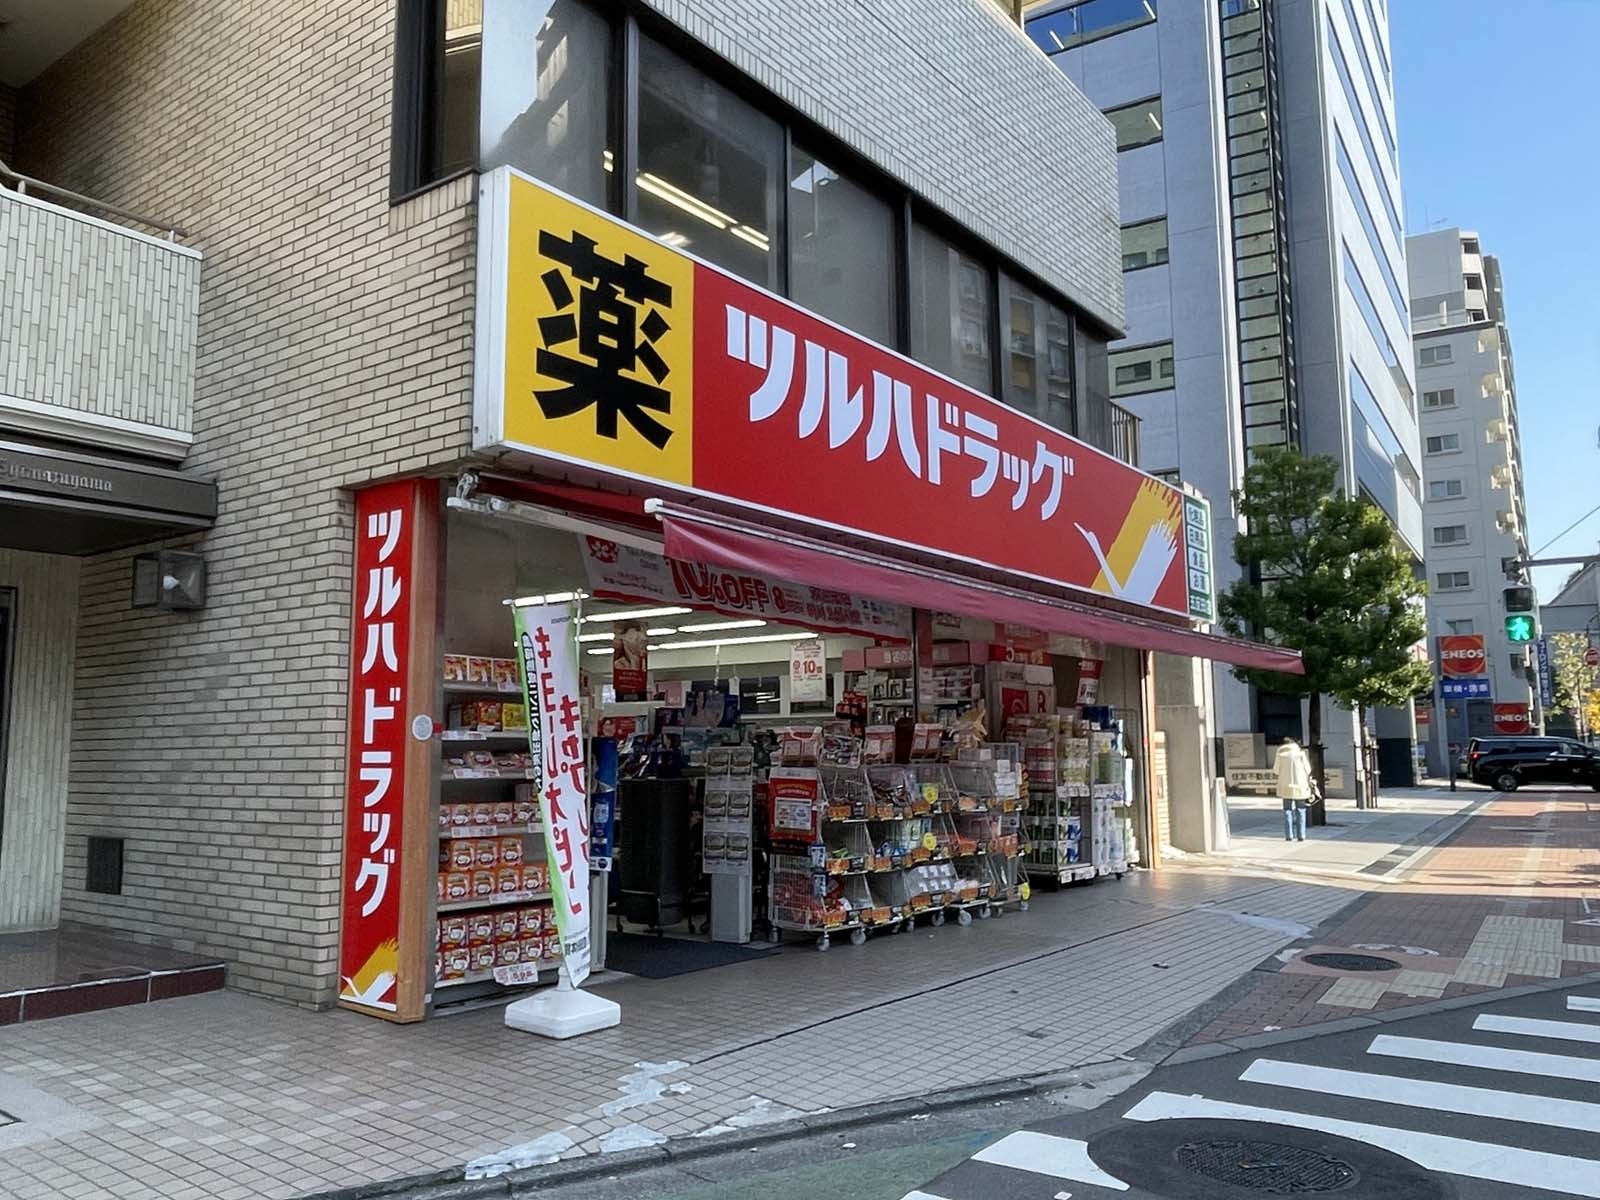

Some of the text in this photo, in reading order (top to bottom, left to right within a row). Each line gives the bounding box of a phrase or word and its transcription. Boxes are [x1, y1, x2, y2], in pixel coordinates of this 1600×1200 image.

[533, 229, 674, 450] 薬
[725, 304, 1075, 521] ツルハドラッグ
[354, 508, 403, 917] ツルハドラッグ
[1440, 649, 1485, 660] ENEOS
